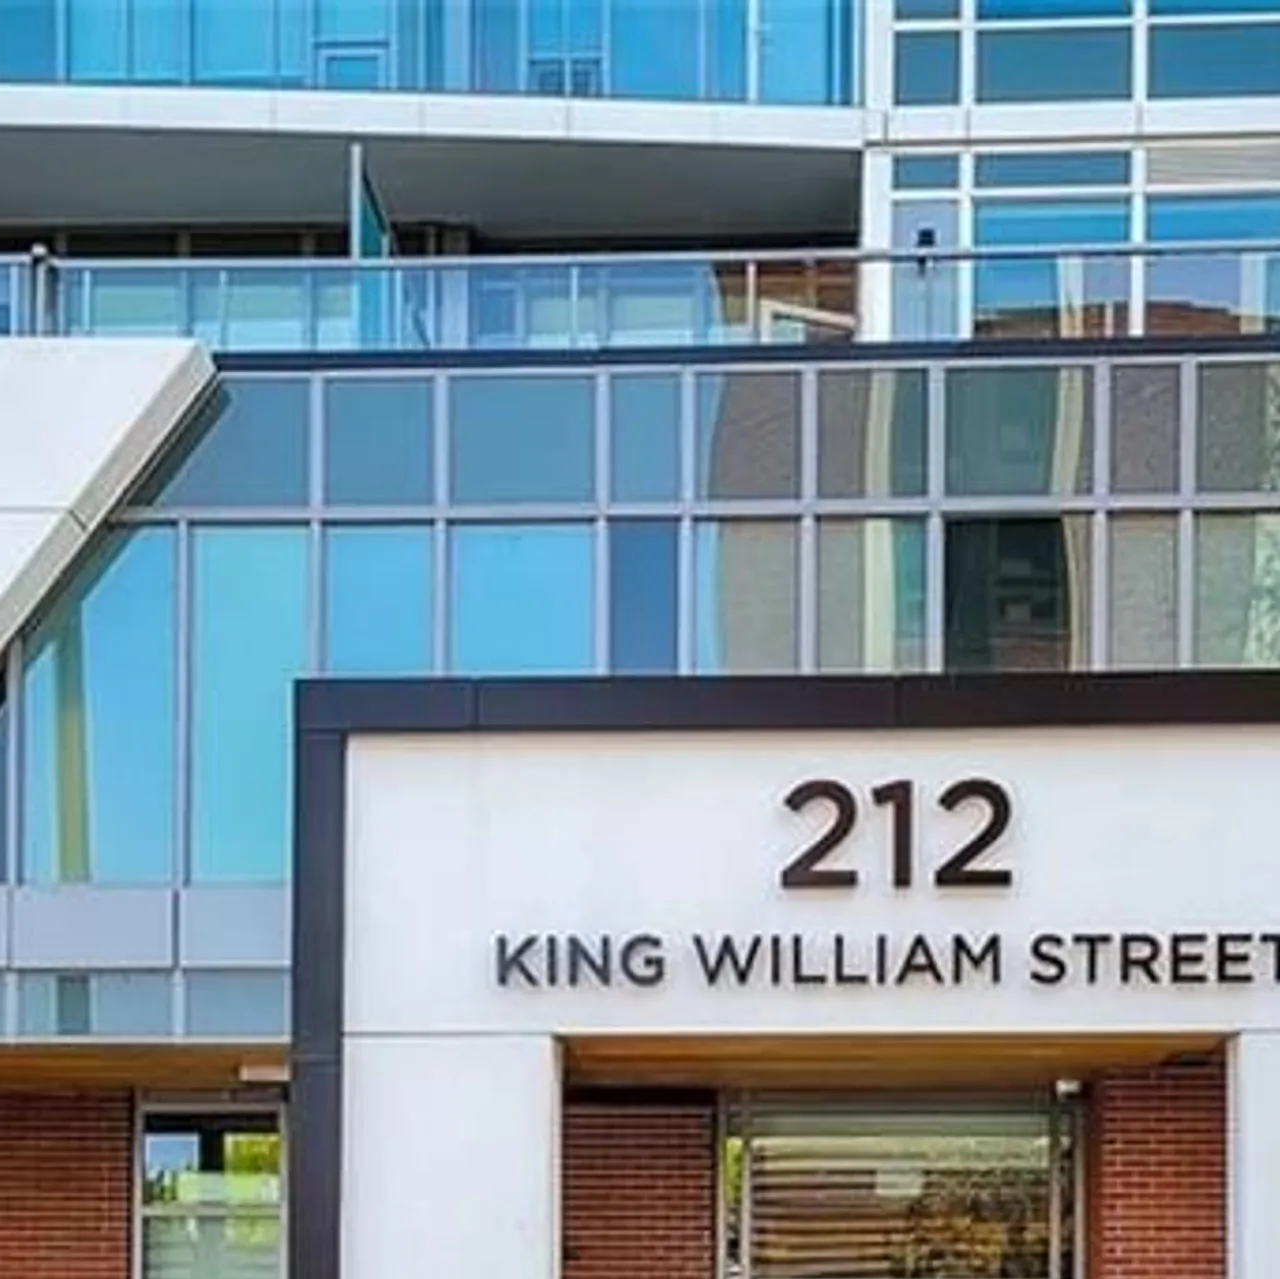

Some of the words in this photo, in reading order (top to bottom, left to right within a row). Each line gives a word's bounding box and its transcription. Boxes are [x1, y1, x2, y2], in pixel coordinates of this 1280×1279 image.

[781, 778, 1012, 888] 212
[496, 933, 665, 987] KING
[694, 933, 1003, 986] WILLIAM
